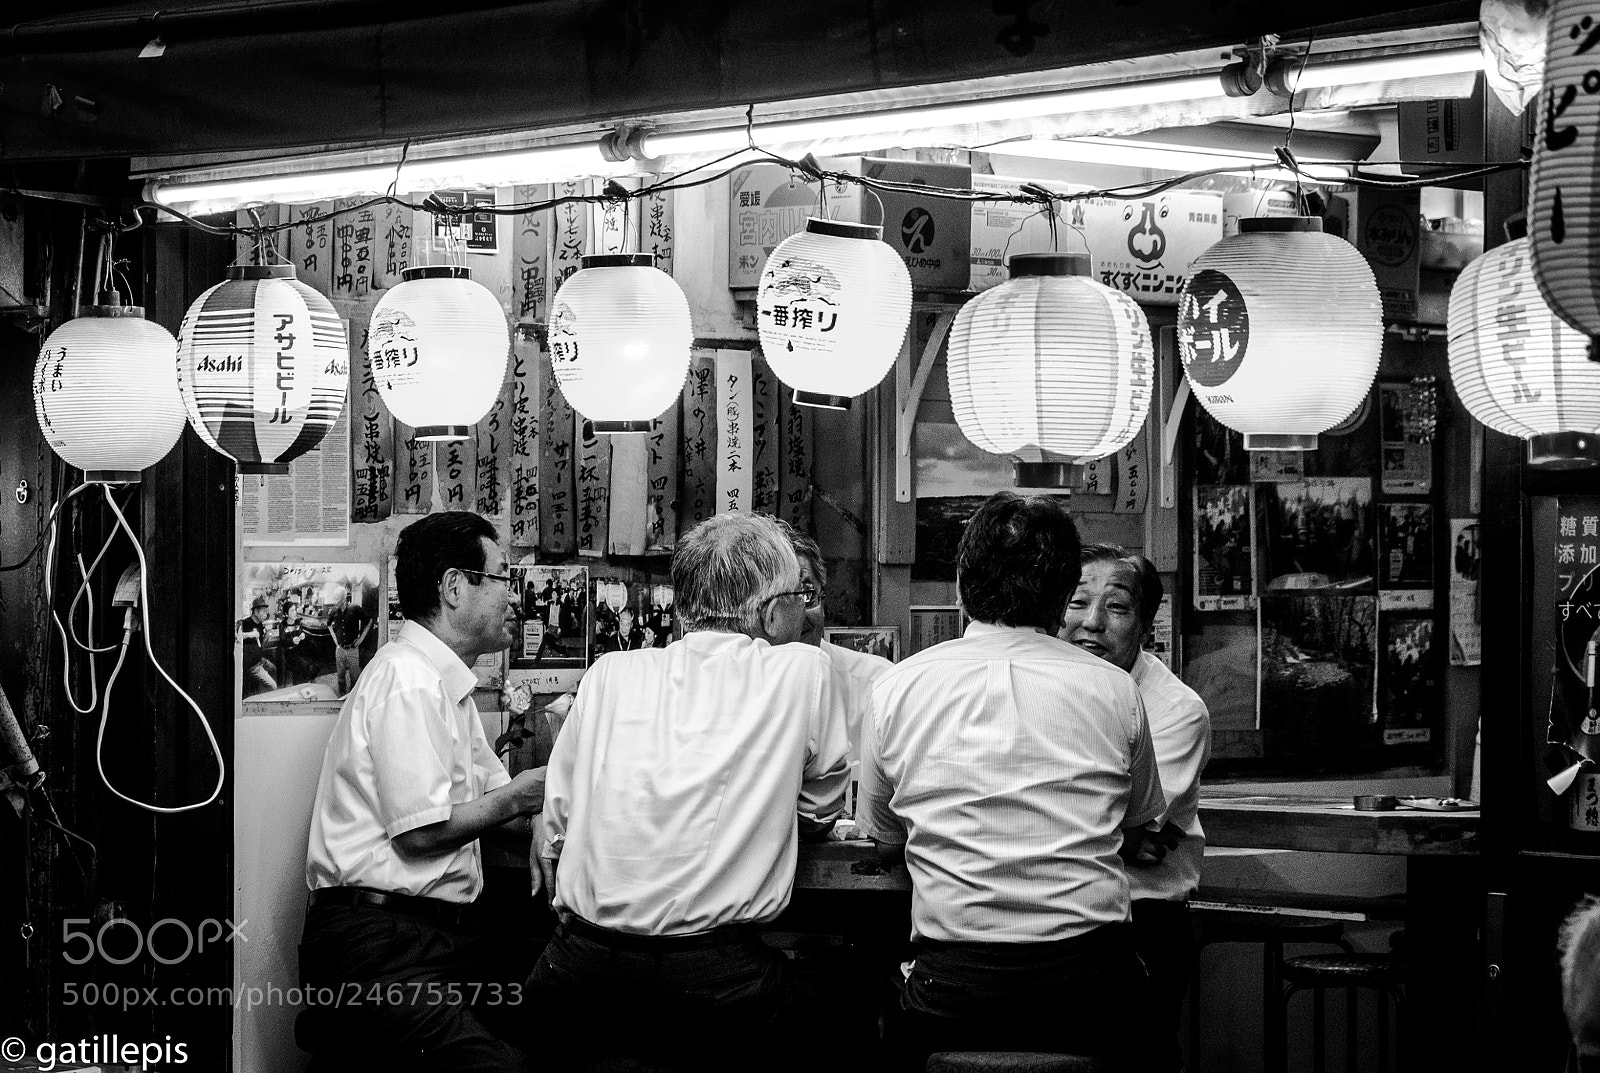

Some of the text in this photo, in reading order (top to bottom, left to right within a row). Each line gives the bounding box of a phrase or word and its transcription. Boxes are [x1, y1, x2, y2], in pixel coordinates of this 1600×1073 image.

[739, 190, 761, 207] 愛媛
[904, 256, 942, 270] えひめ中央
[761, 304, 838, 332] 一番搾り
[52, 346, 68, 392] うまい
[197, 355, 243, 373] Asahi
[268, 314, 297, 424] アサヒビール
[650, 418, 665, 466] トマト
[552, 440, 569, 484] サワー
[1560, 515, 1599, 537] 糖質
[1558, 543, 1598, 565] 添加
